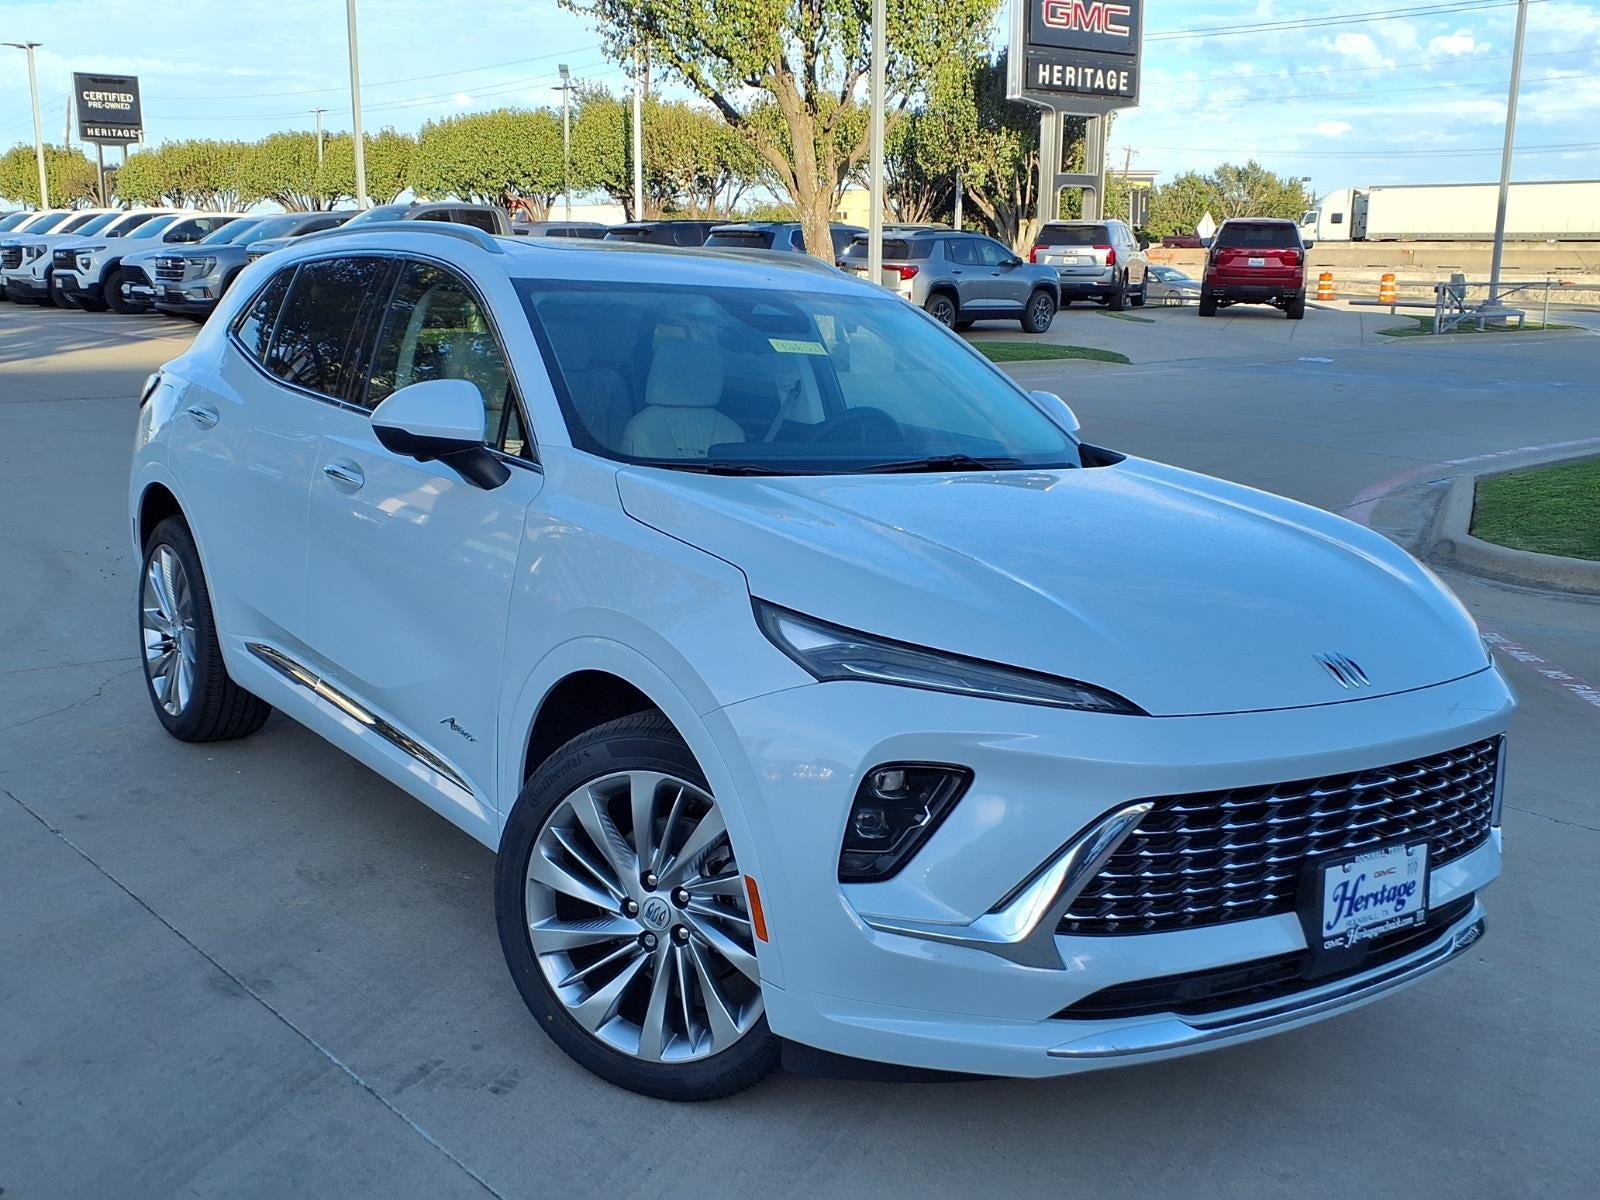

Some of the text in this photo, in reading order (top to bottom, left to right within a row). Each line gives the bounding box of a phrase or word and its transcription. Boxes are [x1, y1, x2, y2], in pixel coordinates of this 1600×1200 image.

[1042, 0, 1130, 37] GMC
[1038, 63, 1129, 91] HERITAGE
[82, 91, 134, 103] CERTIFIED
[87, 101, 131, 110] PRE-OWNED
[87, 127, 137, 138] HERITAGE
[1325, 873, 1416, 931] Heritage
